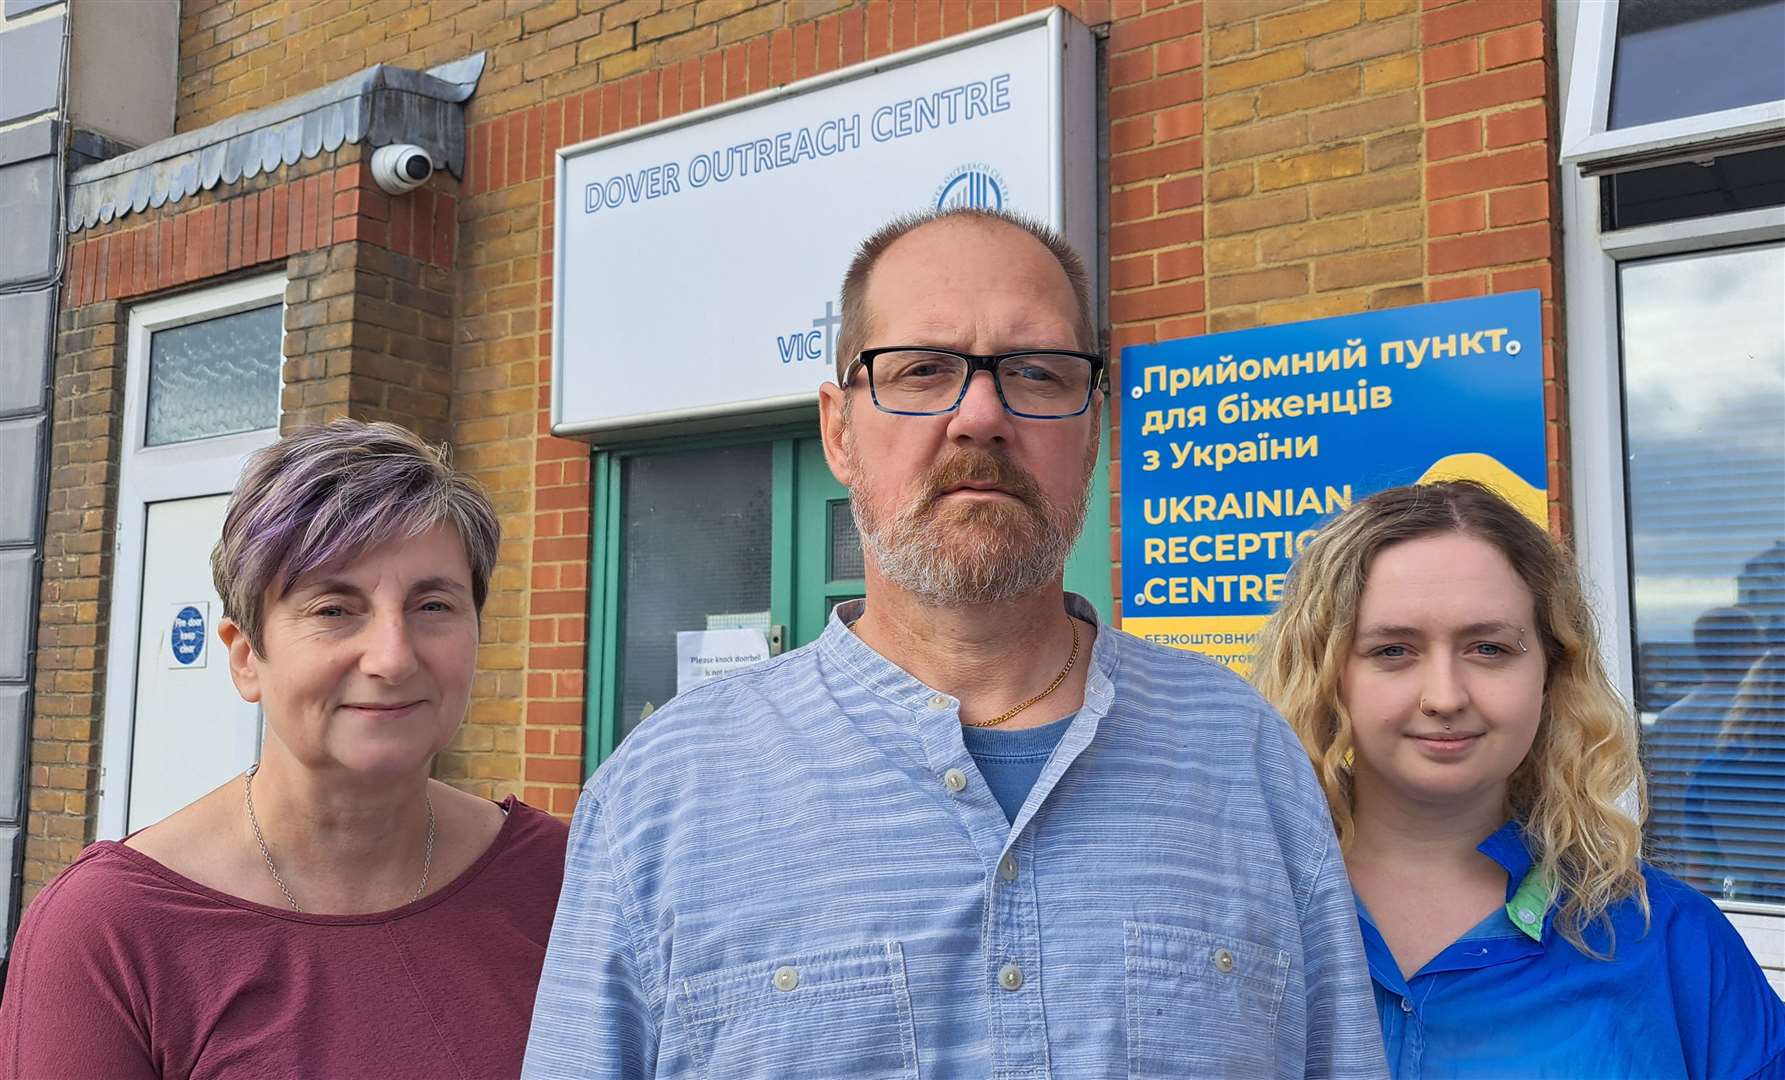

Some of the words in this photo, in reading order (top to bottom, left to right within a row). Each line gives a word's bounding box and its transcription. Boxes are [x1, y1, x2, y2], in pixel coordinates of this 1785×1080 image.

[585, 162, 680, 214] DOVER
[688, 114, 861, 188] OUTREACH
[871, 74, 1010, 142] CENTRE
[1144, 338, 1367, 397] Прийомний
[1380, 327, 1508, 369] пункт
[1142, 405, 1206, 436] для
[1217, 379, 1393, 424] біженців
[1142, 449, 1161, 471] з
[1169, 432, 1319, 471] України
[1143, 484, 1352, 525] UKRAINIAN
[1143, 573, 1286, 605] CENTRE
[1145, 633, 1259, 645] БЕЗКОШТОВНИ
